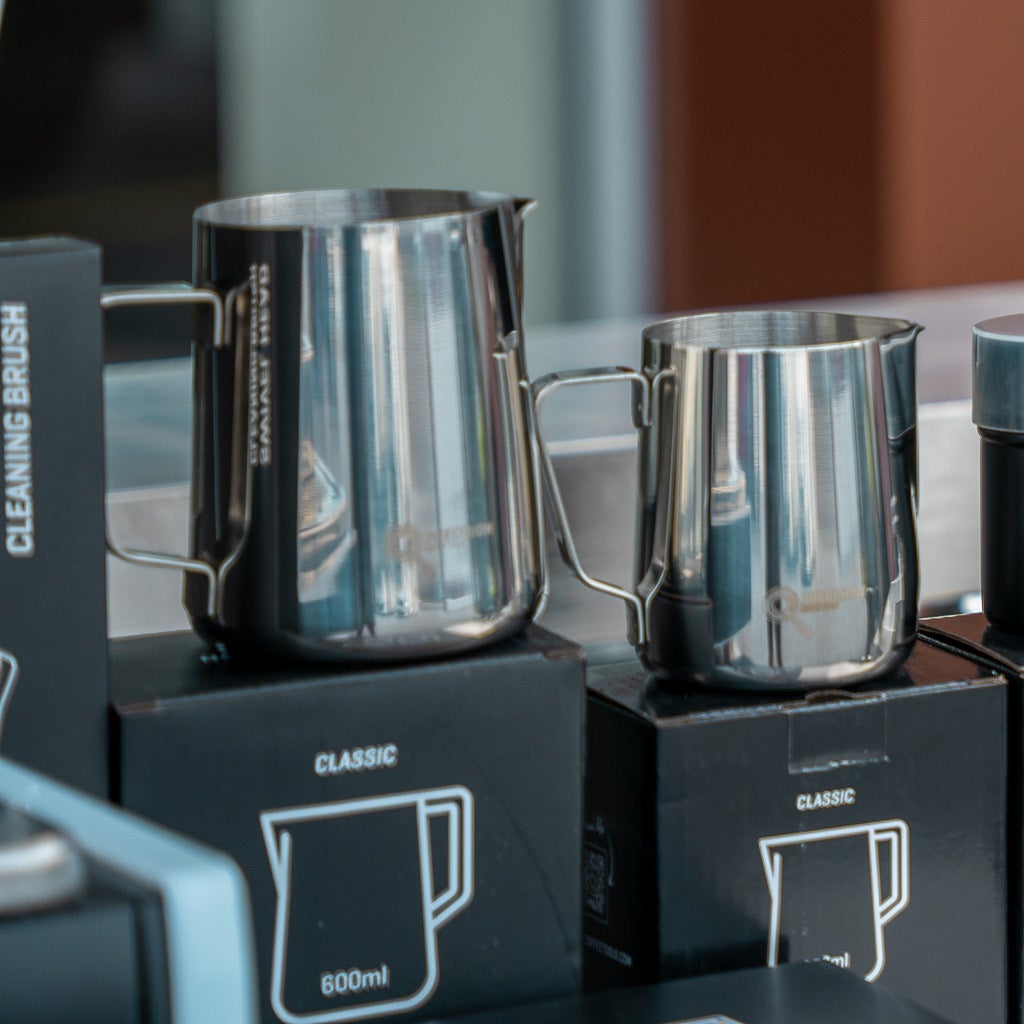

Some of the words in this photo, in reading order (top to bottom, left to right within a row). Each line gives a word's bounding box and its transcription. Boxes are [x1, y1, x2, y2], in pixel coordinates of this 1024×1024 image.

[1, 302, 30, 407] BRUSH
[3, 410, 34, 557] CLEANING
[315, 744, 397, 776] CLASSIC
[796, 787, 856, 811] CLASSIC
[321, 963, 389, 996] 600ml
